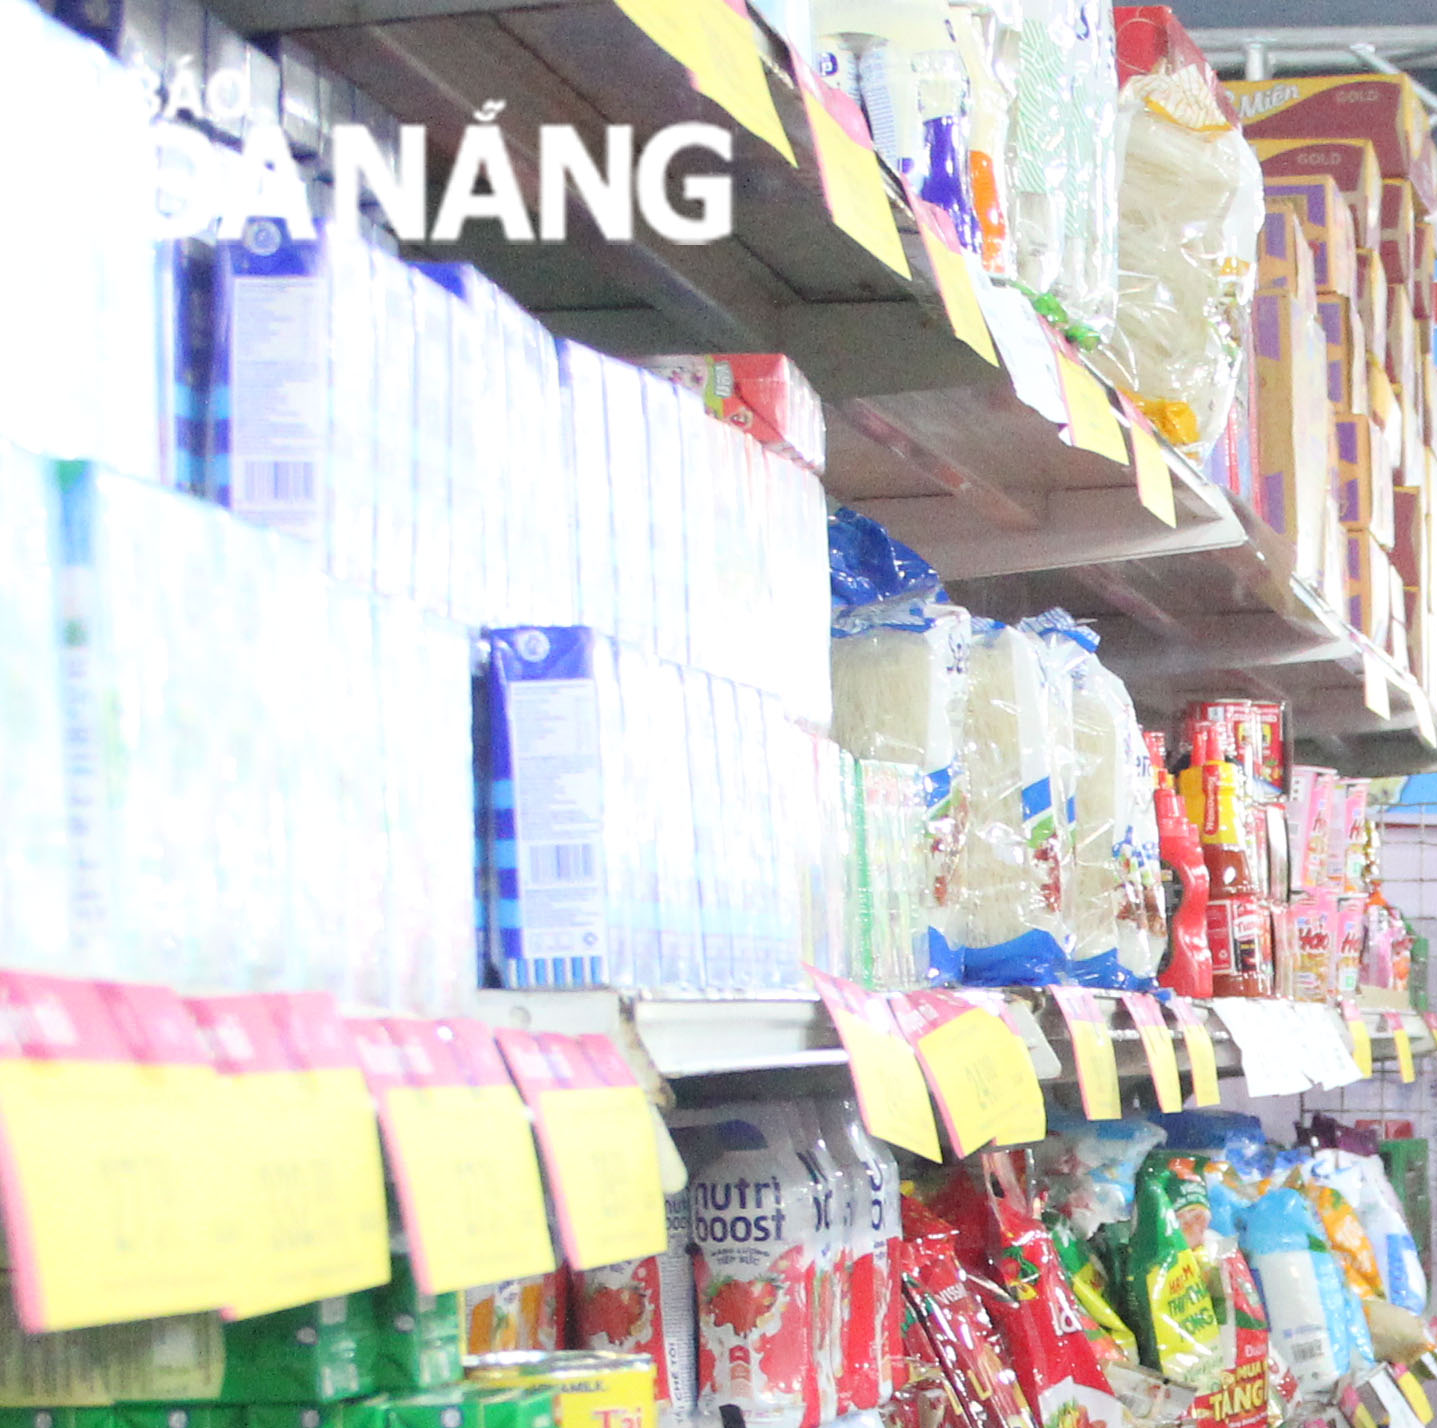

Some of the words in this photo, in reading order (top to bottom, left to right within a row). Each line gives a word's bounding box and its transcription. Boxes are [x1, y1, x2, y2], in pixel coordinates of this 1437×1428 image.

[1335, 90, 1379, 103] GOLD
[1297, 152, 1342, 166] GOLD
[695, 1176, 782, 1211] nutri
[695, 1207, 786, 1243] boost
